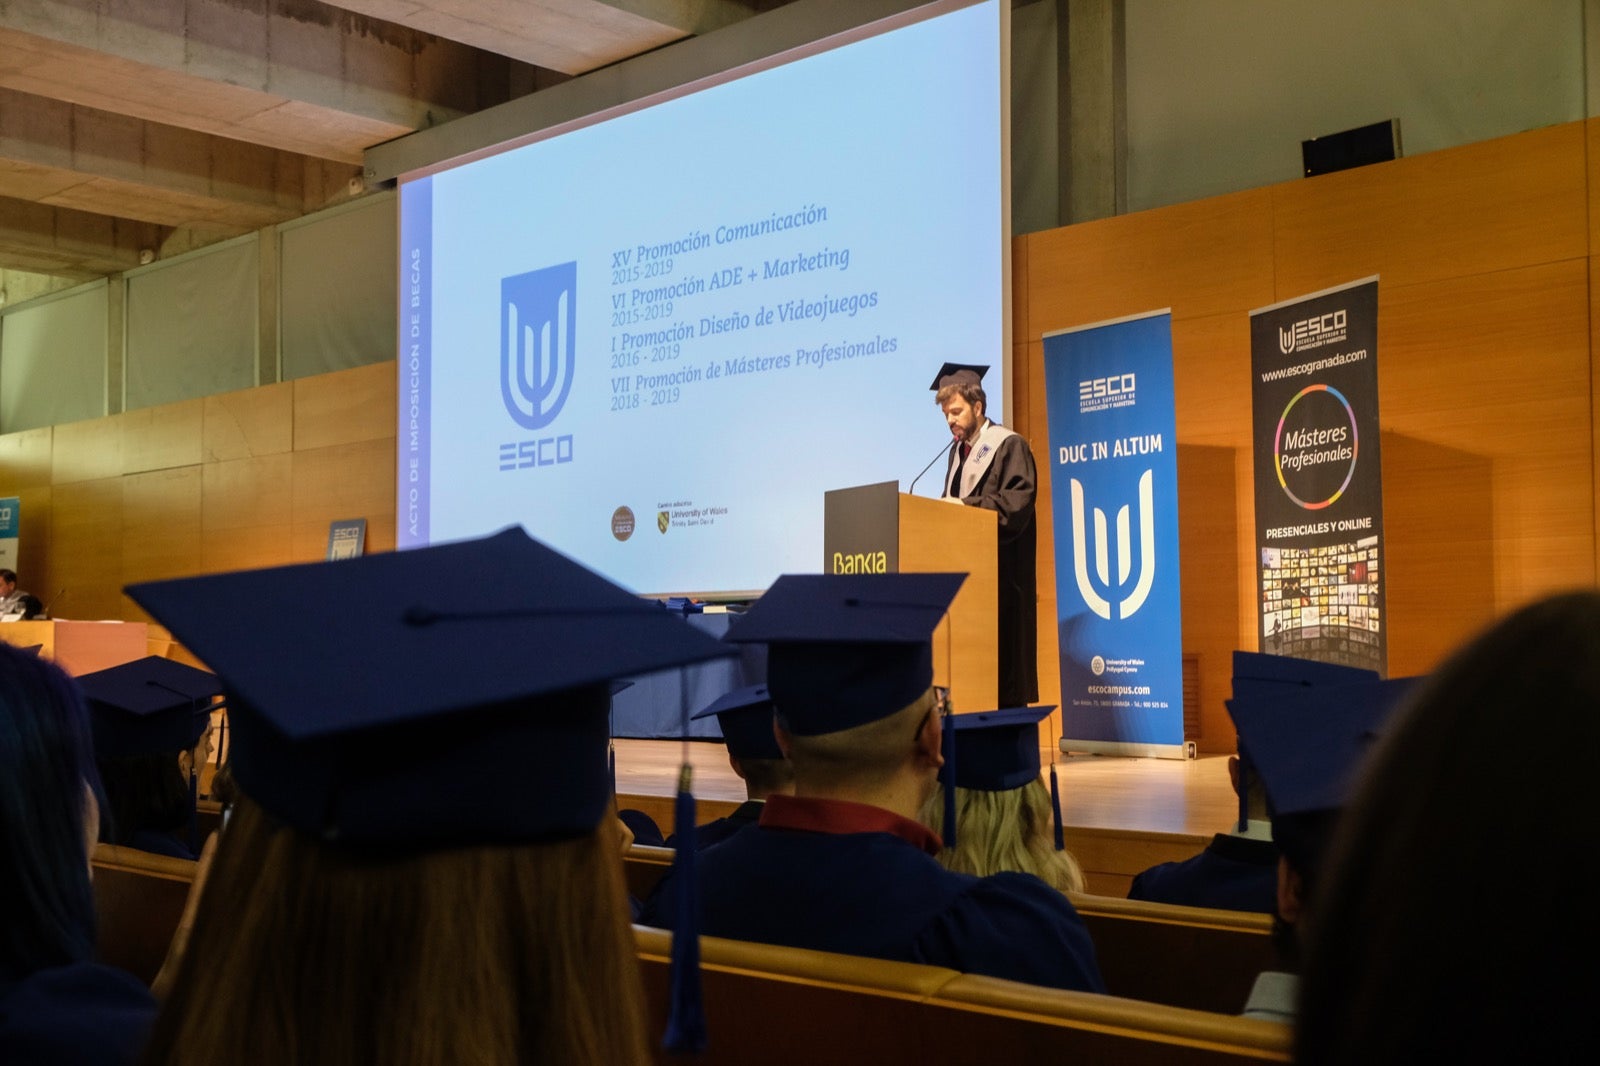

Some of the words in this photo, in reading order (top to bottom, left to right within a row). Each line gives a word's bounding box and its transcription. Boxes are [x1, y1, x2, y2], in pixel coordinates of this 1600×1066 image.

[611, 249, 632, 268] XV
[637, 231, 711, 263] Promoción
[715, 203, 828, 245] Comunicación
[411, 248, 421, 308] BECAS
[611, 259, 674, 286] 2015-2019
[612, 293, 627, 310] VI
[631, 275, 705, 306] Promoción
[708, 266, 743, 291] ADE
[747, 268, 758, 282] +
[763, 247, 850, 280] Marketing
[411, 313, 420, 338] DE
[611, 301, 674, 327] 2015-2019
[611, 336, 616, 353] I
[621, 321, 695, 351] Promoción
[700, 312, 750, 337] Diseño
[755, 306, 774, 327] de
[778, 291, 879, 322] Videojuegos
[1296, 309, 1346, 339] ESCO
[1296, 336, 1315, 346] ESCUELA
[1317, 331, 1339, 341] SUPERIOR
[611, 350, 640, 369] 2016
[651, 343, 681, 362] 2019
[611, 376, 631, 394] VII
[636, 365, 702, 391] Promoción
[706, 361, 721, 379] de
[724, 355, 791, 377] Másteres
[796, 335, 898, 369] Profesionales
[1262, 349, 1367, 383] www.escogranada.com
[409, 344, 420, 451] IMPOSICIÓN
[610, 392, 640, 411] 2018
[651, 387, 681, 405] 2019
[1080, 373, 1135, 400] ESCO
[1080, 399, 1100, 407] ESCUELA
[1102, 394, 1126, 404] SUPERIOR
[1060, 443, 1087, 464] DUC
[1091, 441, 1107, 460] IN
[1113, 433, 1162, 458] ALTUM
[1285, 426, 1347, 451] Másteres
[500, 434, 573, 471] ESCO
[1281, 445, 1352, 472] Profesionales
[410, 458, 419, 482] DE
[409, 488, 418, 536] ACTO
[672, 510, 700, 519] University
[710, 507, 728, 516] Wales
[1266, 521, 1329, 539] PRESENCIALES
[1330, 521, 1337, 532] Y
[1338, 517, 1372, 531] ONLINE
[833, 551, 887, 575] Bankia
[1088, 685, 1151, 696] escocampus.com
